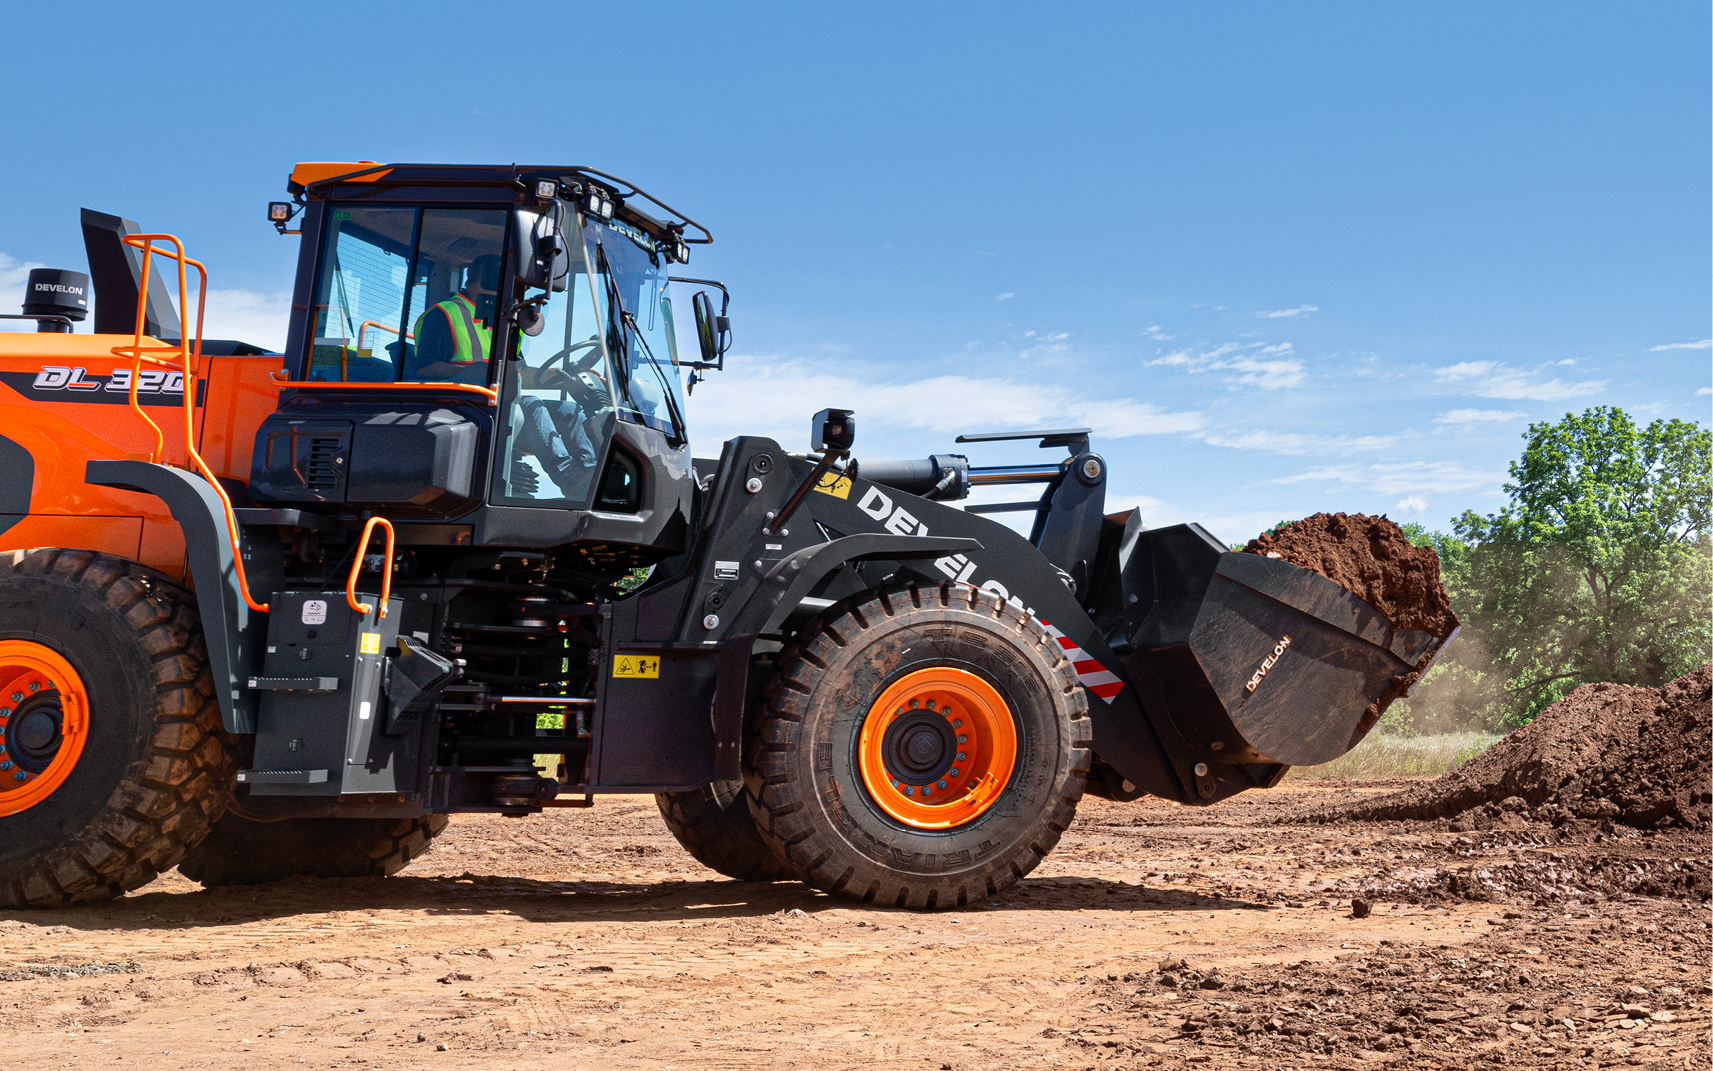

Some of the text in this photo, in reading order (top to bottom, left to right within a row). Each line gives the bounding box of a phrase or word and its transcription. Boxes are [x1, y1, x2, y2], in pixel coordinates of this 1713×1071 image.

[35, 283, 83, 295] DEVELON
[32, 365, 192, 394] DL 320
[1245, 635, 1291, 692] DEVELON
[818, 742, 1001, 868] TRIANGLE
